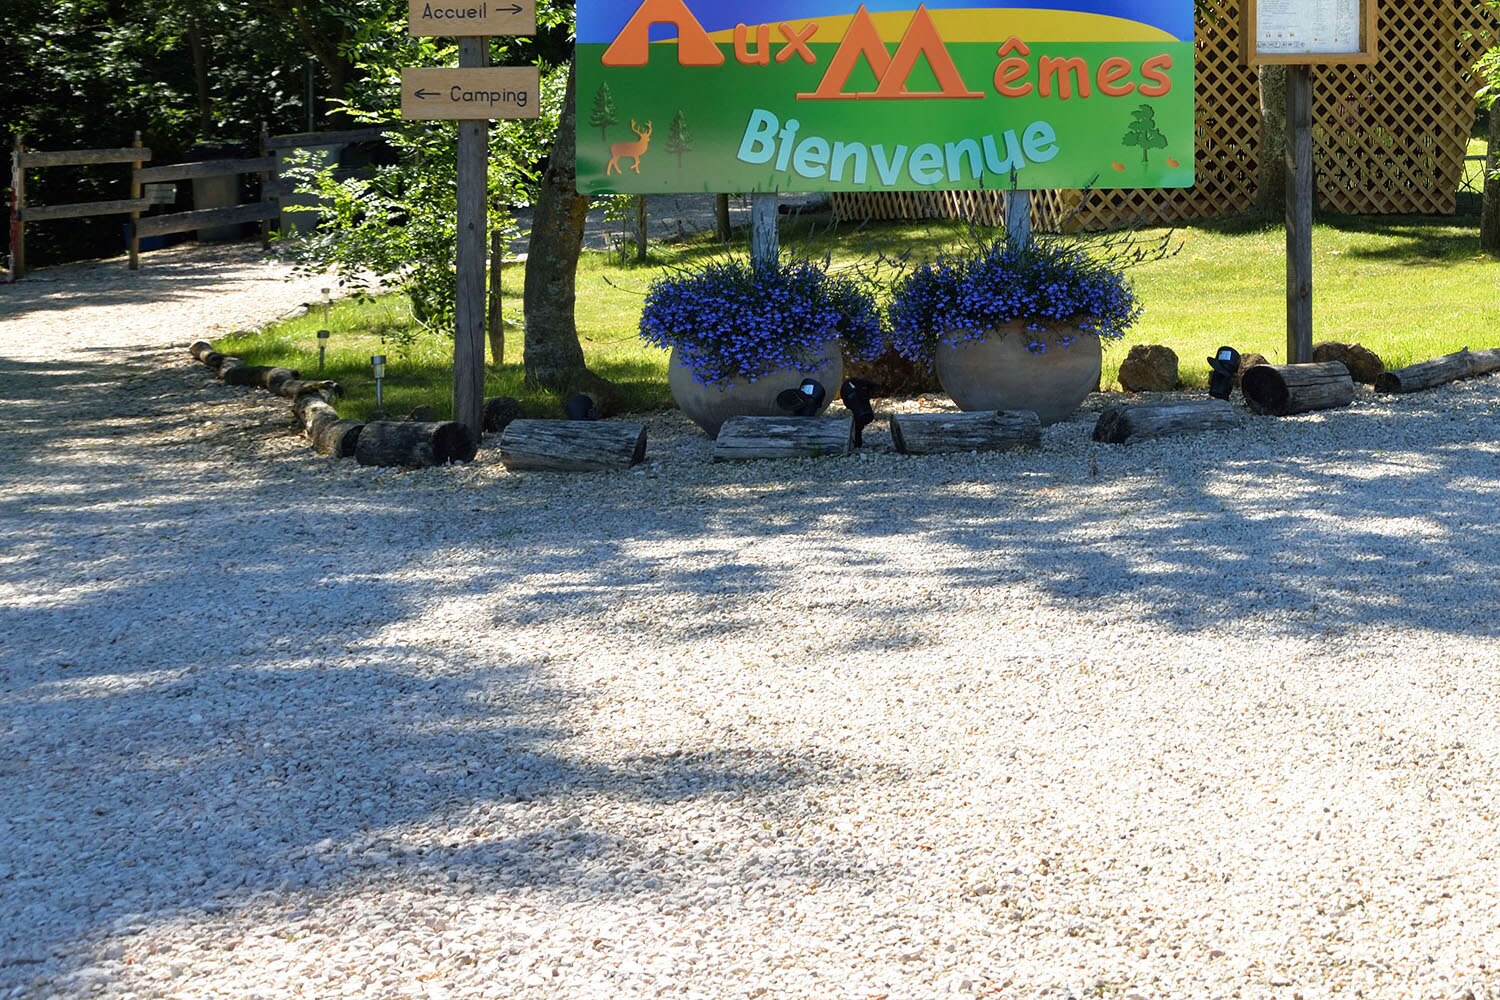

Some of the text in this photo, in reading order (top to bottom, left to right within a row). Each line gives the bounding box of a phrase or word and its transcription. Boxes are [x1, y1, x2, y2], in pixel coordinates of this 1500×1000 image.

[422, 2, 487, 19] Accueil
[796, 2, 1174, 100] Mêmes
[450, 85, 528, 107] Camping
[737, 107, 1060, 186] Bienvenue
